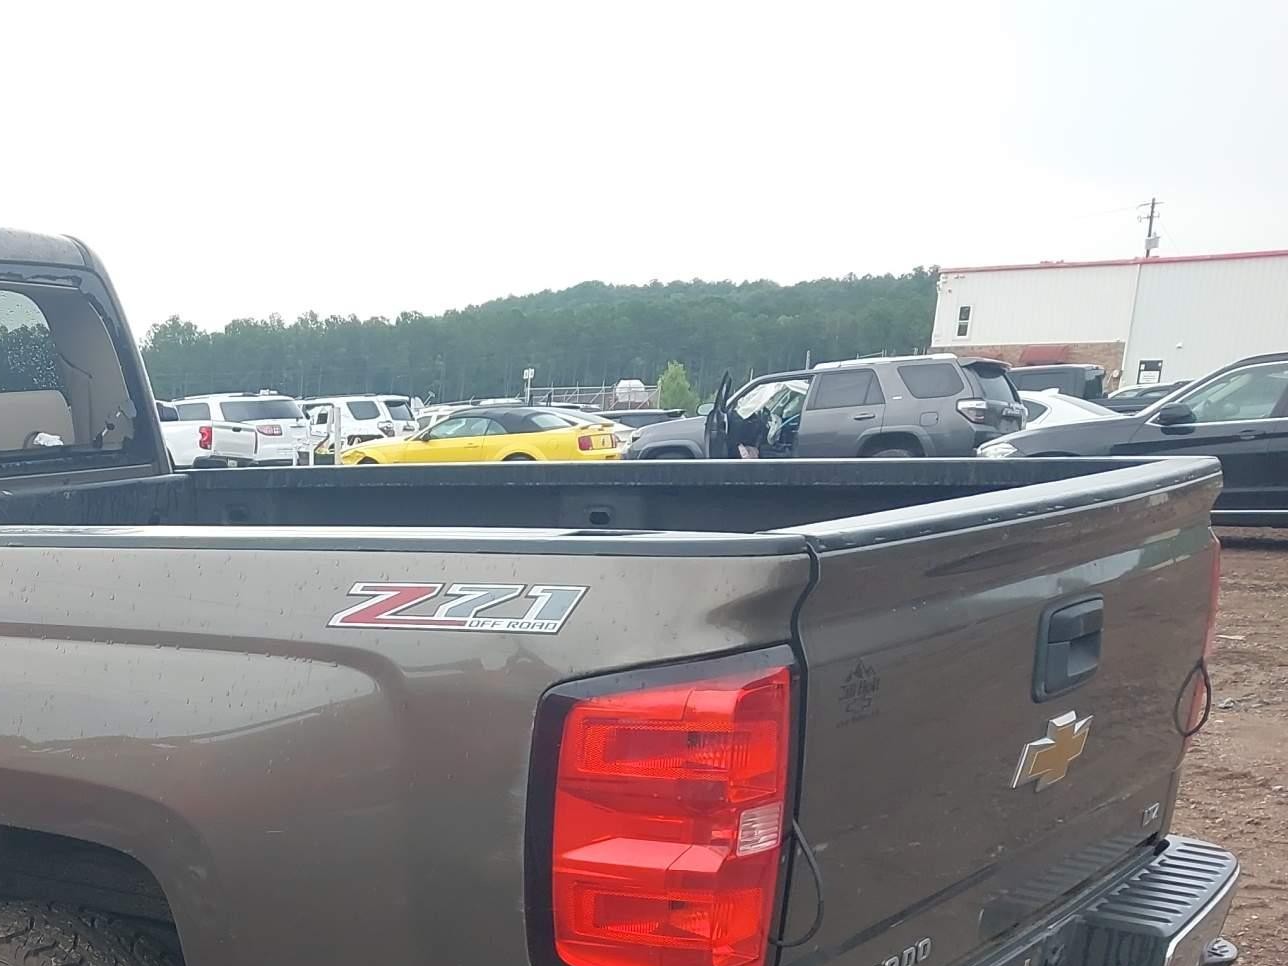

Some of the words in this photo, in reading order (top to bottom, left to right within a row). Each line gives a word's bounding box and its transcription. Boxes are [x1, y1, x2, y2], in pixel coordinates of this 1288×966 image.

[327, 581, 591, 629] Z71
[468, 620, 501, 628] OFF
[506, 620, 559, 630] ROAD
